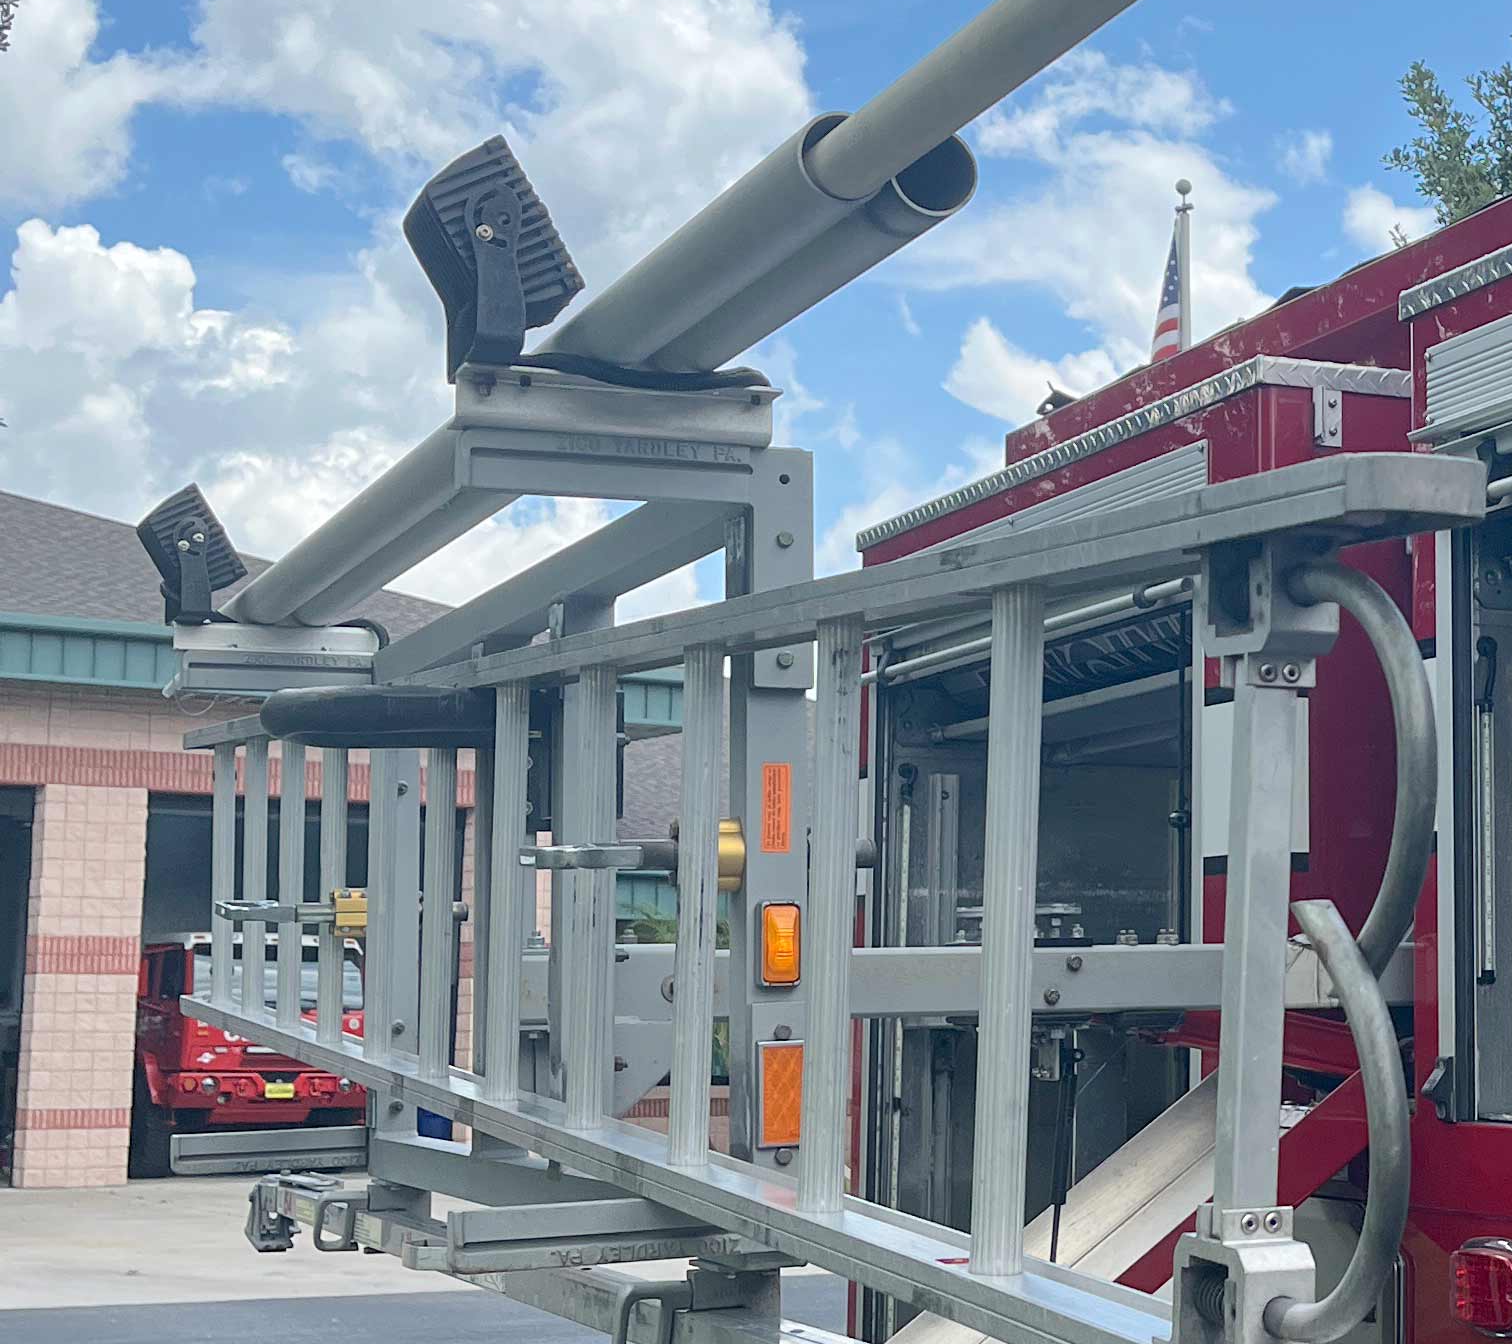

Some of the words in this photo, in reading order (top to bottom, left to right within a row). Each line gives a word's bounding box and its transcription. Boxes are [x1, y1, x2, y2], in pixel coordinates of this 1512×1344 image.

[556, 432, 599, 452] ZICO
[615, 437, 701, 460] YARDLEY
[713, 445, 743, 463] PA.
[597, 1239, 685, 1263] YARDLEY
